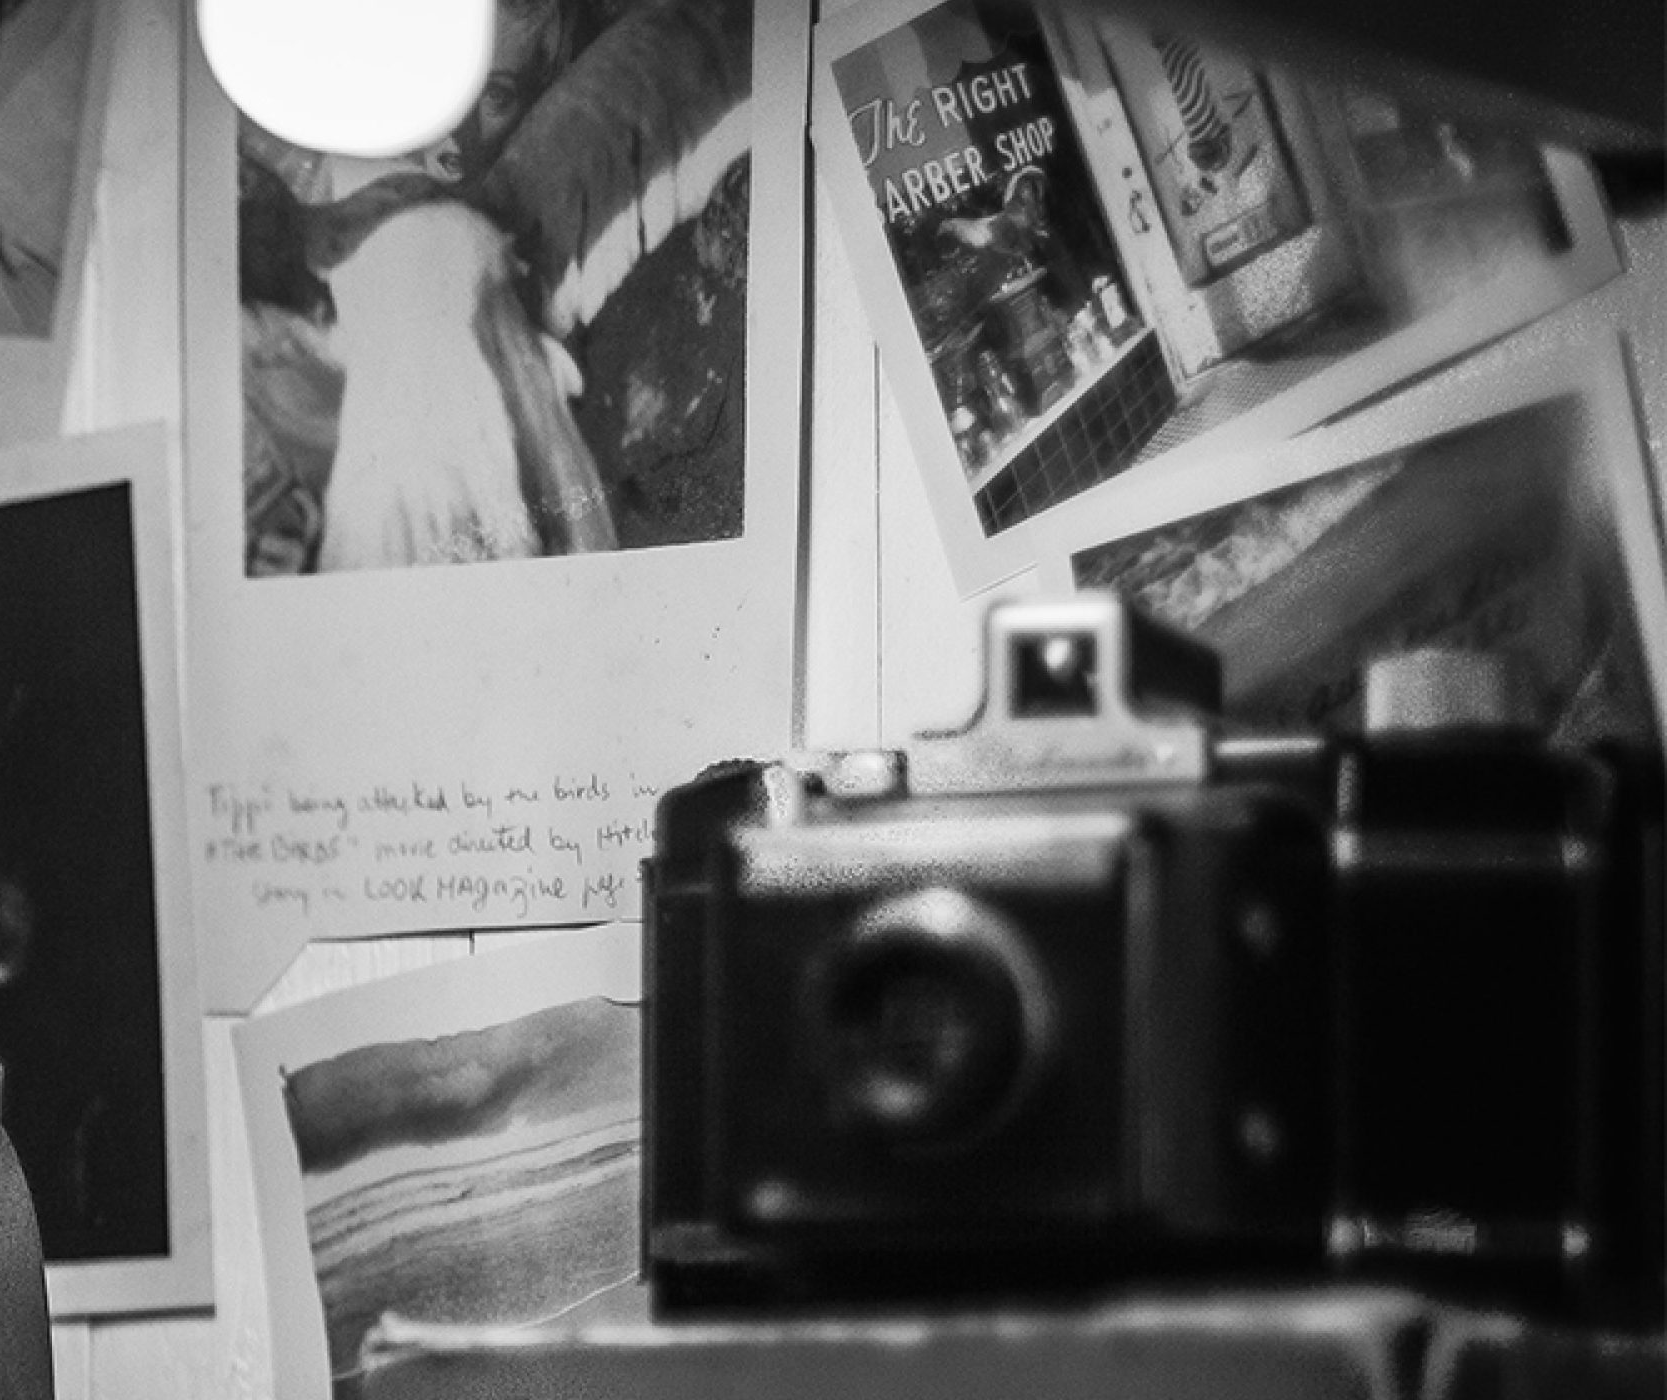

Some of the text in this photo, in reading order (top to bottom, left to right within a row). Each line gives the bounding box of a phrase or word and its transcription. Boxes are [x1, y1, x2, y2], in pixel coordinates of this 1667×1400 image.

[932, 63, 1031, 126] RIGHT
[884, 116, 1055, 223] ARBER SHOP
[462, 781, 492, 818] by
[553, 773, 610, 801] birds
[549, 827, 582, 865] by
[364, 874, 426, 903] LOOK
